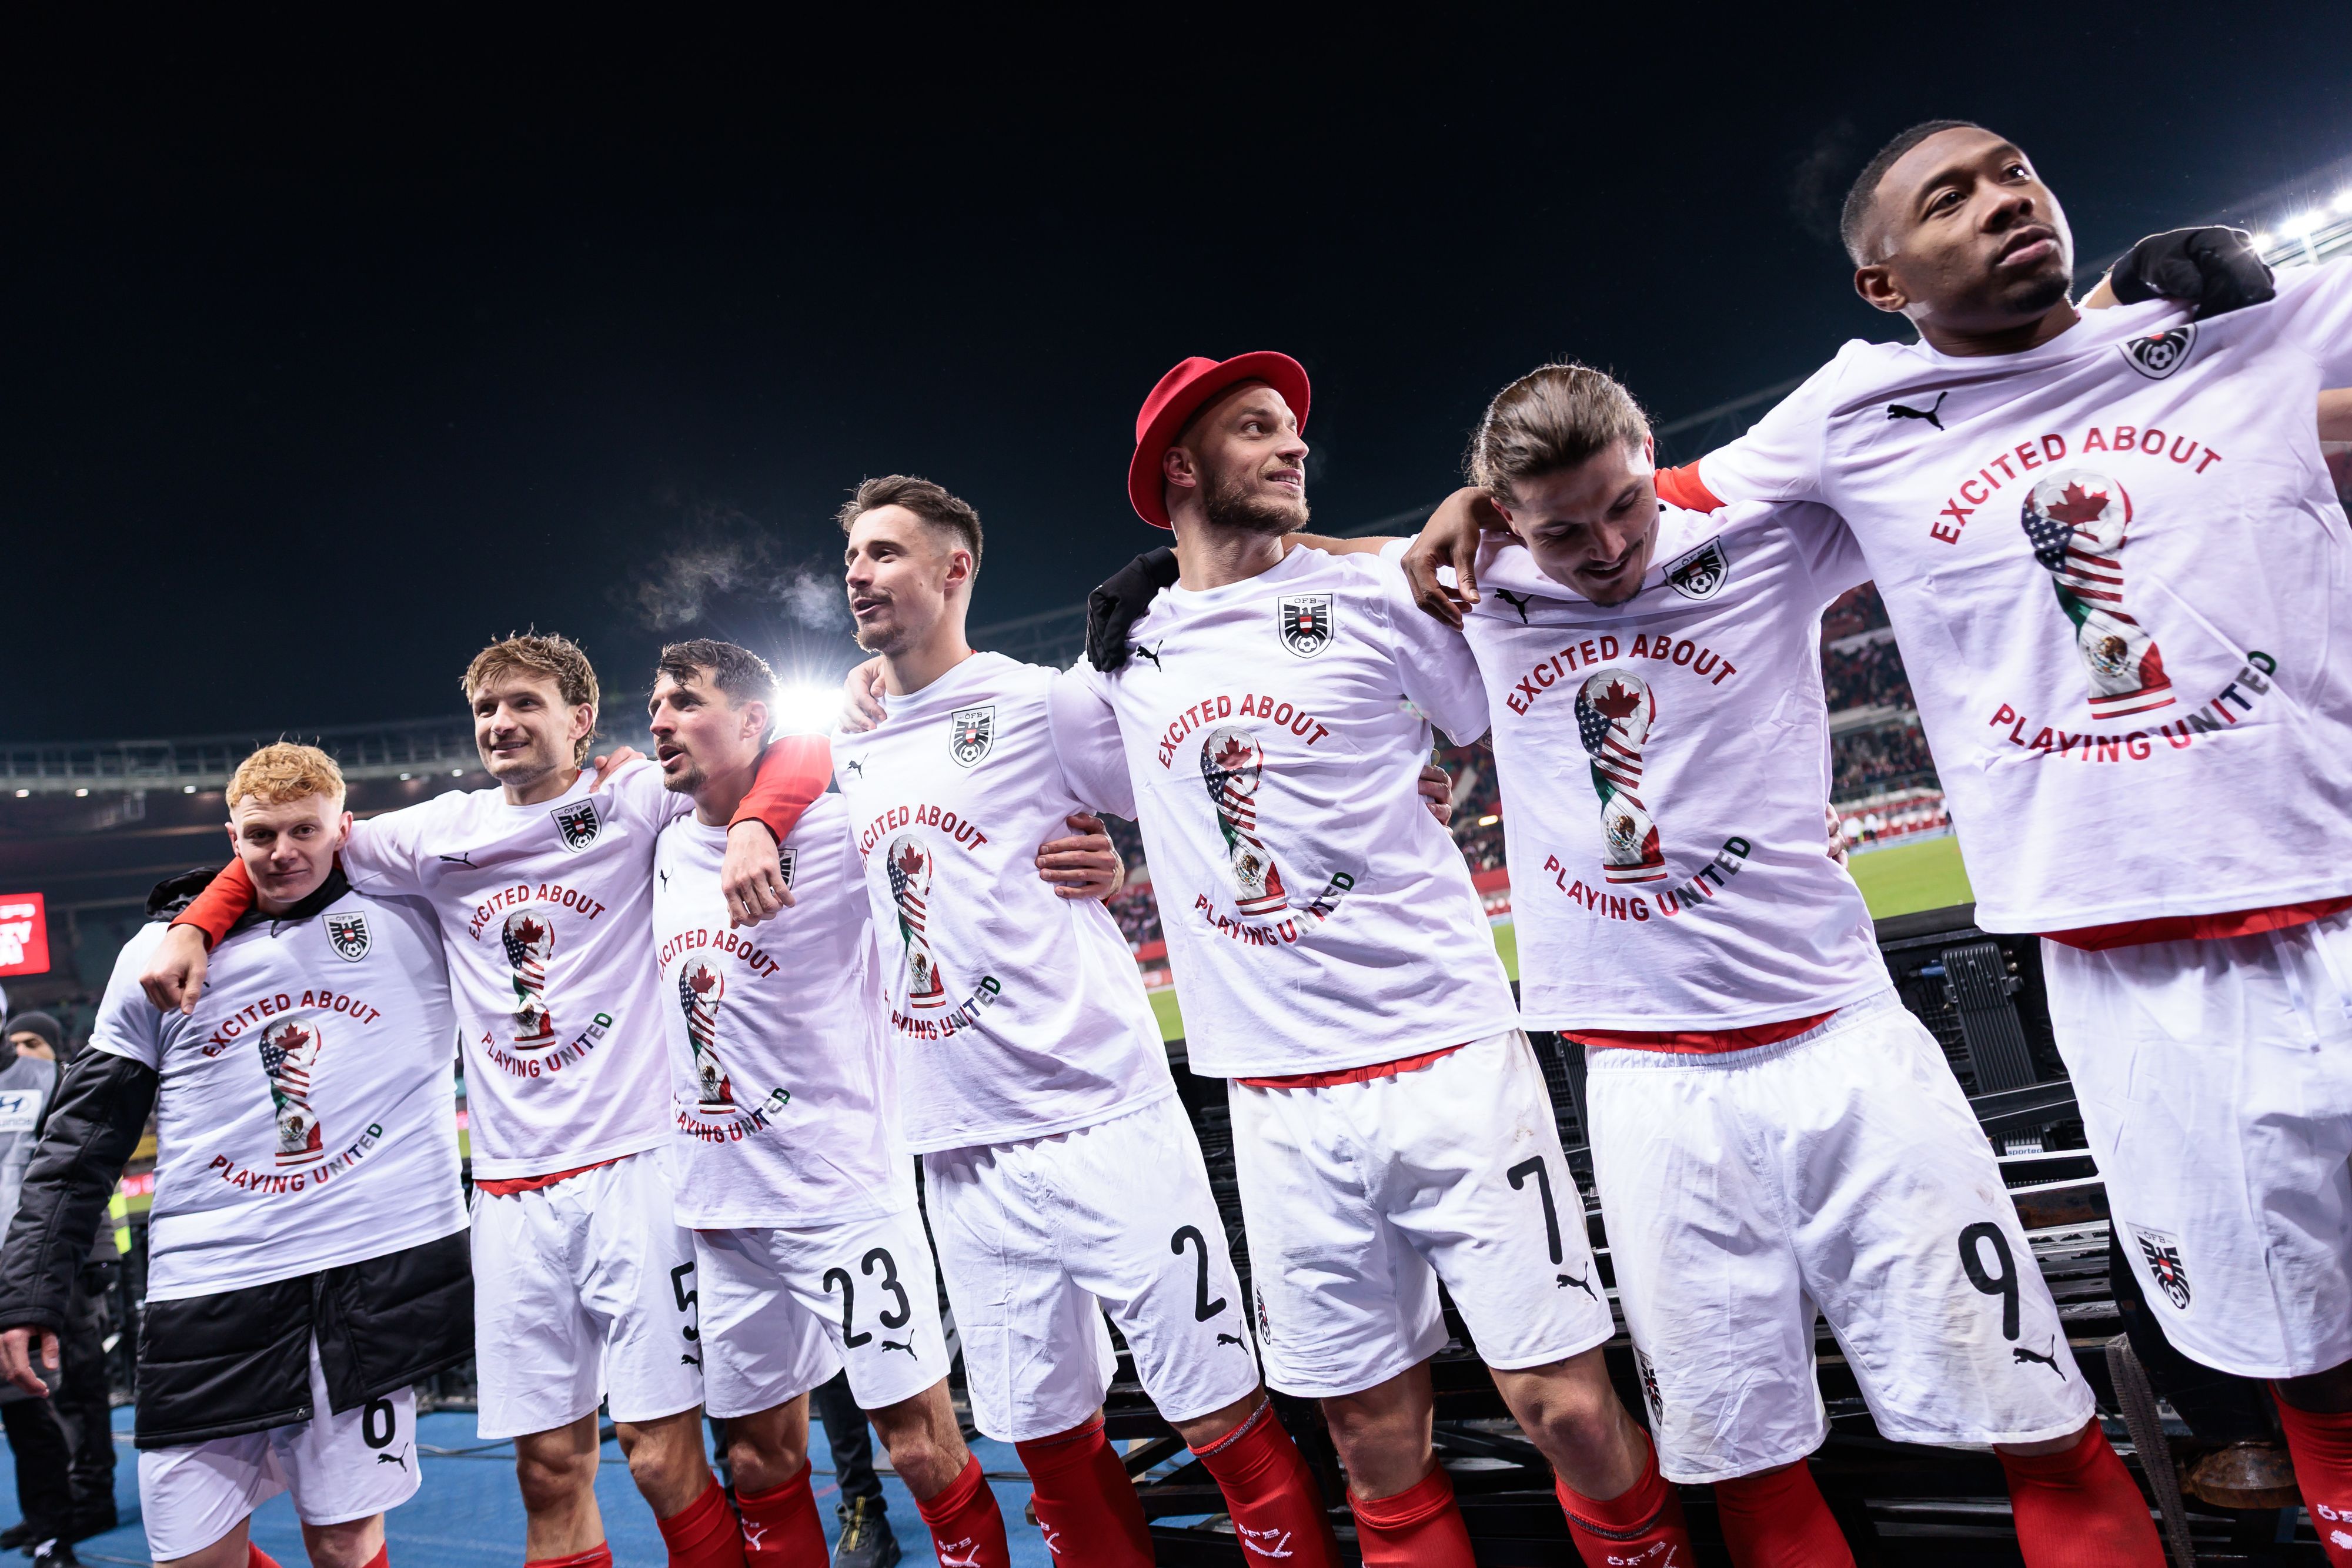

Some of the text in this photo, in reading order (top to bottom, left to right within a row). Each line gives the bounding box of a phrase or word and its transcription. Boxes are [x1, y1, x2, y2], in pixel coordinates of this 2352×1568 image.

[1929, 425, 2223, 545] EXCITED ABOUT
[1506, 634, 1737, 717] EXCITED ABOUT
[1988, 650, 2277, 763] PLAYING UNITED
[1158, 694, 1329, 770] EXCITED ABOUT
[915, 804, 988, 852] ABOUT
[469, 884, 606, 942] EXCITED ABOUT
[1194, 871, 1356, 945] PLAYING UNITED
[1544, 835, 1752, 922] PLAYING UNITED
[712, 930, 780, 978] ABOUT
[202, 990, 380, 1058] EXCITED ABOUT
[940, 975, 1002, 1037] UNITED
[482, 1012, 613, 1078] PLAYING UNITED
[728, 1087, 791, 1142] UNITED
[209, 1122, 383, 1193] PLAYING UNITED
[1506, 1155, 1563, 1265] 7
[670, 1261, 698, 1341] 5
[823, 1247, 911, 1349] 23
[1171, 1225, 1227, 1322] 2
[1957, 1222, 2020, 1340] 9
